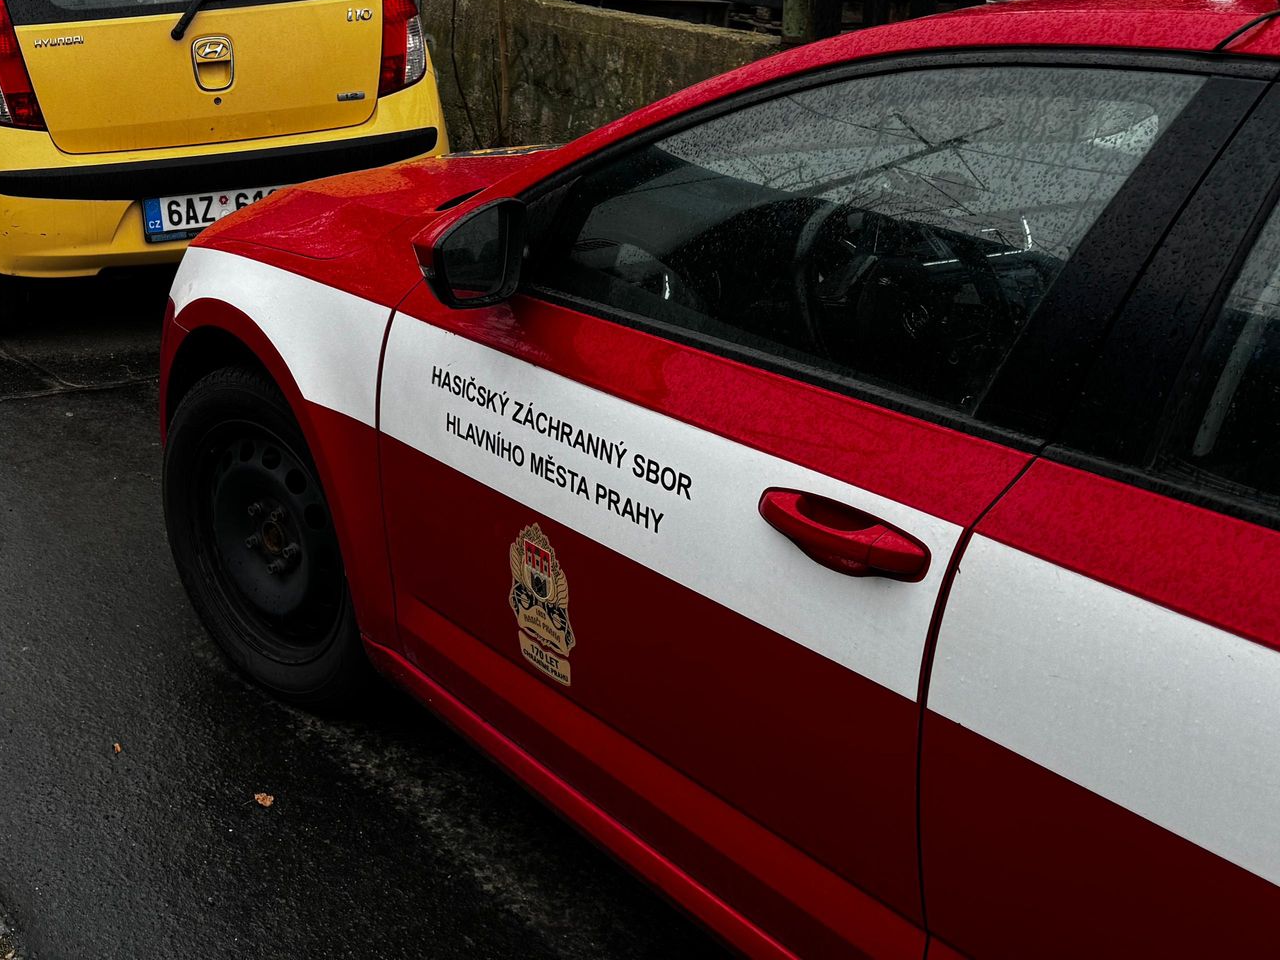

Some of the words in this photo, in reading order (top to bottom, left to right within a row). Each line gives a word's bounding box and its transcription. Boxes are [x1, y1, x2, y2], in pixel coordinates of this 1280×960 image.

[346, 7, 373, 22] i10
[34, 35, 84, 48] HYUNDAI
[148, 220, 161, 229] CZ
[167, 196, 216, 227] 6AZ
[431, 365, 509, 416] HASIČSKÝ
[512, 401, 627, 469] ZÁCHRANNÝ
[632, 453, 692, 500] SBOR
[446, 412, 525, 467] HLAVNÍHO
[530, 452, 590, 501] MĚSTA
[596, 483, 664, 534] PRAHY
[530, 644, 544, 660] 170
[545, 653, 560, 670] LET
